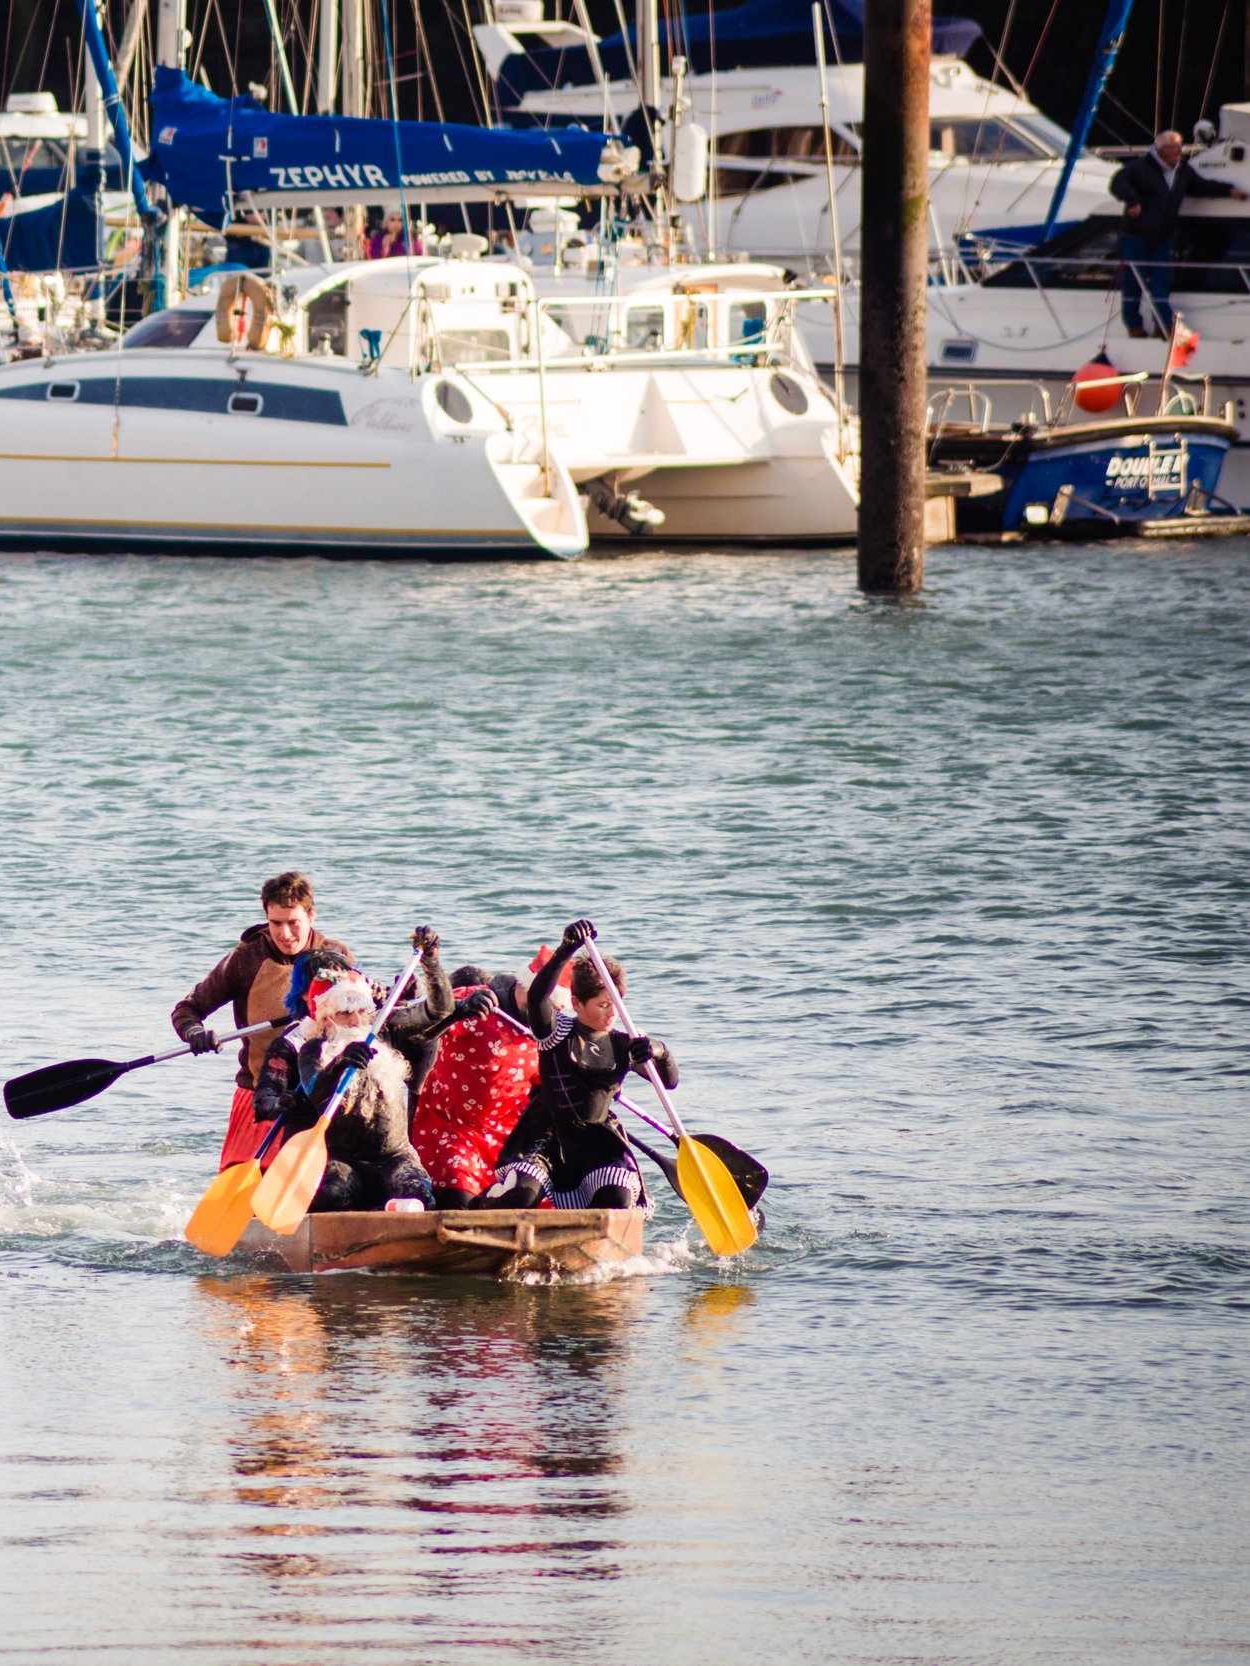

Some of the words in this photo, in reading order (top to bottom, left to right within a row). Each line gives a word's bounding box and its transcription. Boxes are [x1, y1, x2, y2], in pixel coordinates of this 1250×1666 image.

[269, 164, 390, 188] ZEPHYR
[401, 170, 471, 186] POWERED
[474, 170, 495, 182] BY
[1105, 456, 1173, 477] DOUBLE
[1114, 476, 1138, 489] PORT
